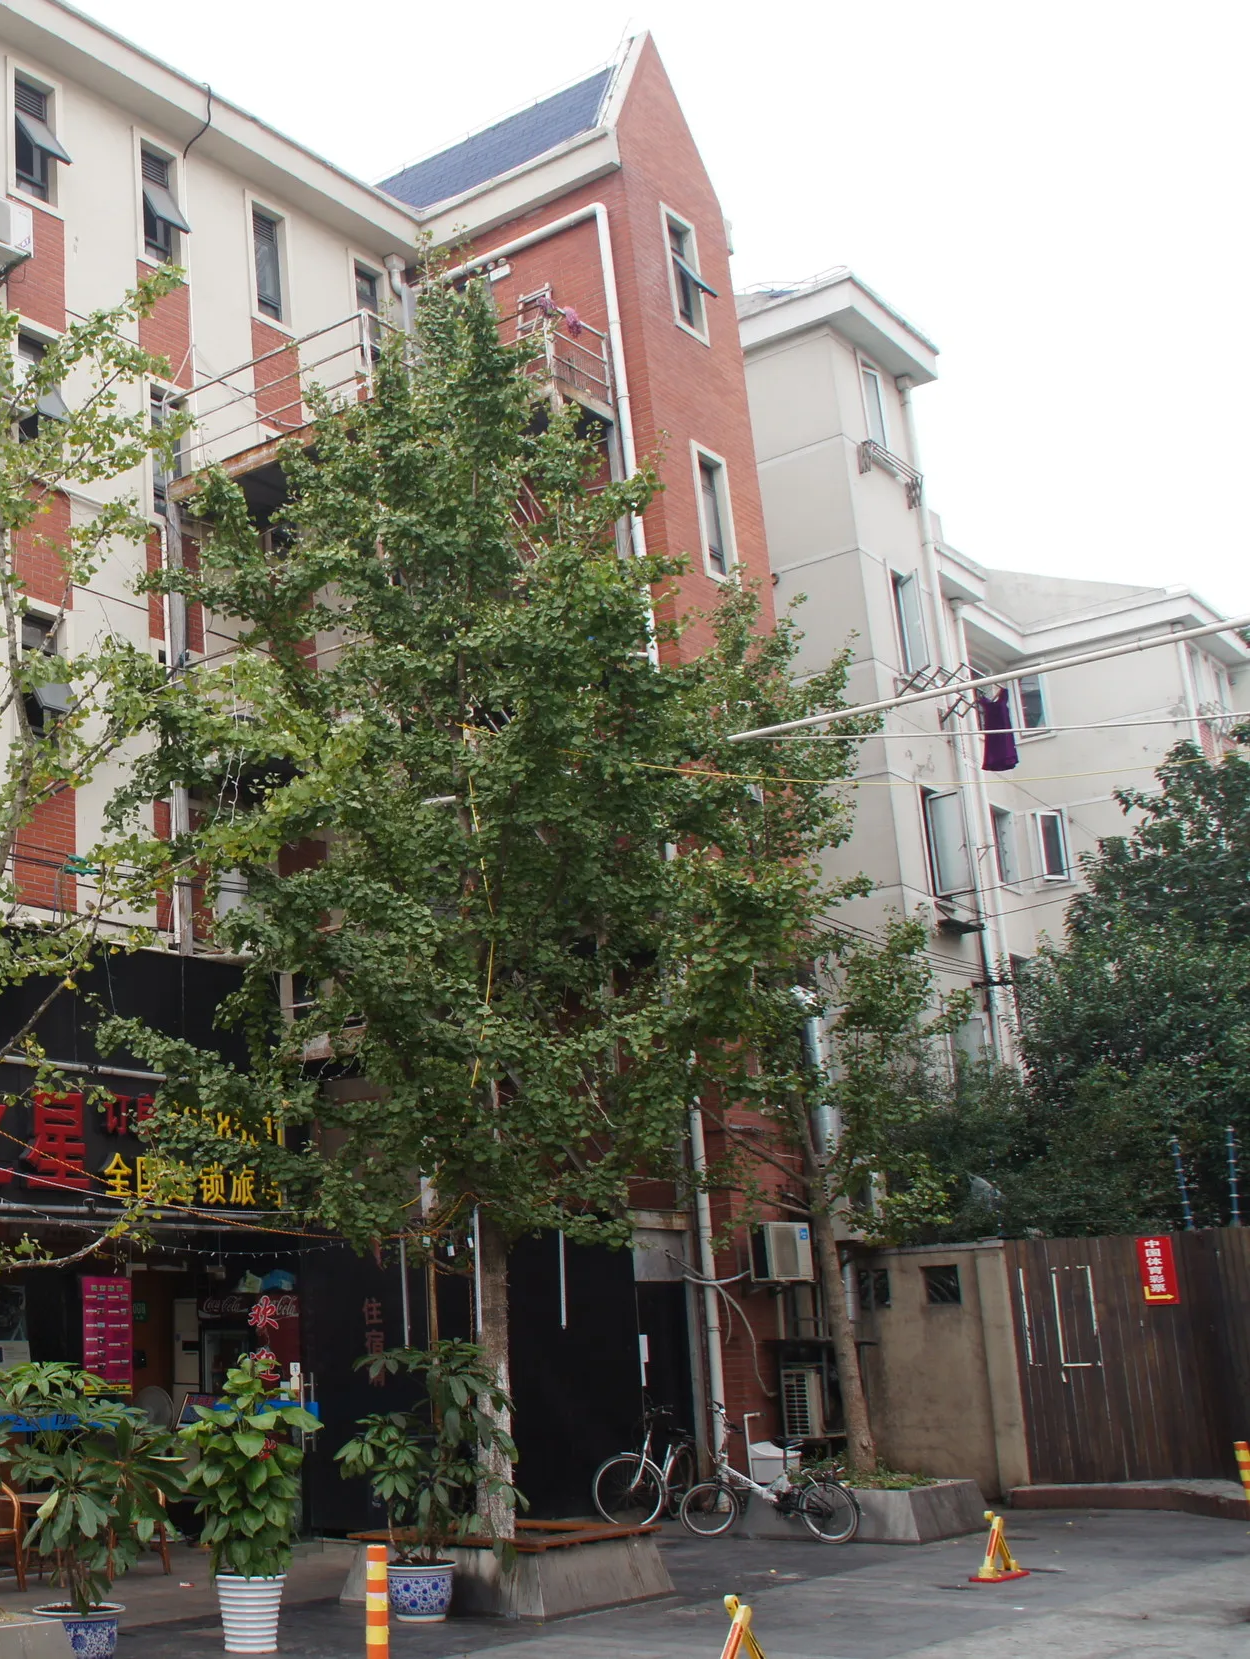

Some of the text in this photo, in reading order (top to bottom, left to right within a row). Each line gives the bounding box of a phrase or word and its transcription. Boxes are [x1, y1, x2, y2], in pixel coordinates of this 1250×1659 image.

[103, 1152, 283, 1208] 全国锁旅
[1144, 1239, 1167, 1293] 中国体育彩票
